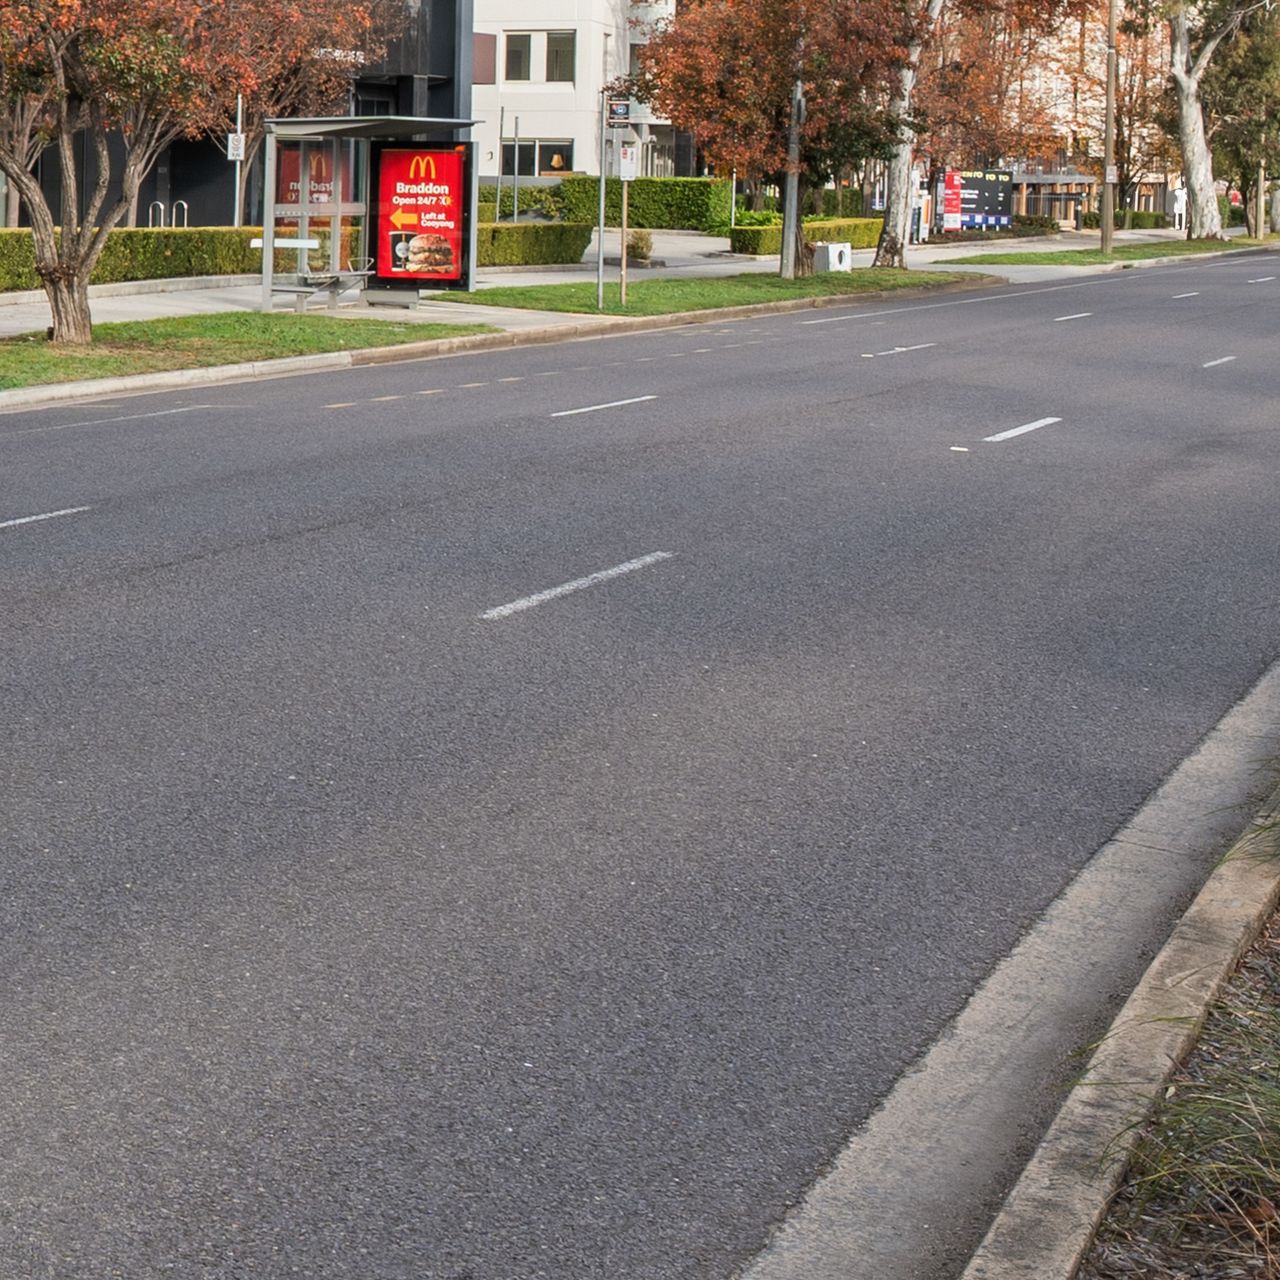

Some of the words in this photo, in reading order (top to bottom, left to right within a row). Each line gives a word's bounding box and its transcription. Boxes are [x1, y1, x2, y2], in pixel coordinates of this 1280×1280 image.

[396, 182, 449, 195] Braddon
[392, 196, 416, 207] Open
[417, 196, 437, 206] 24/7
